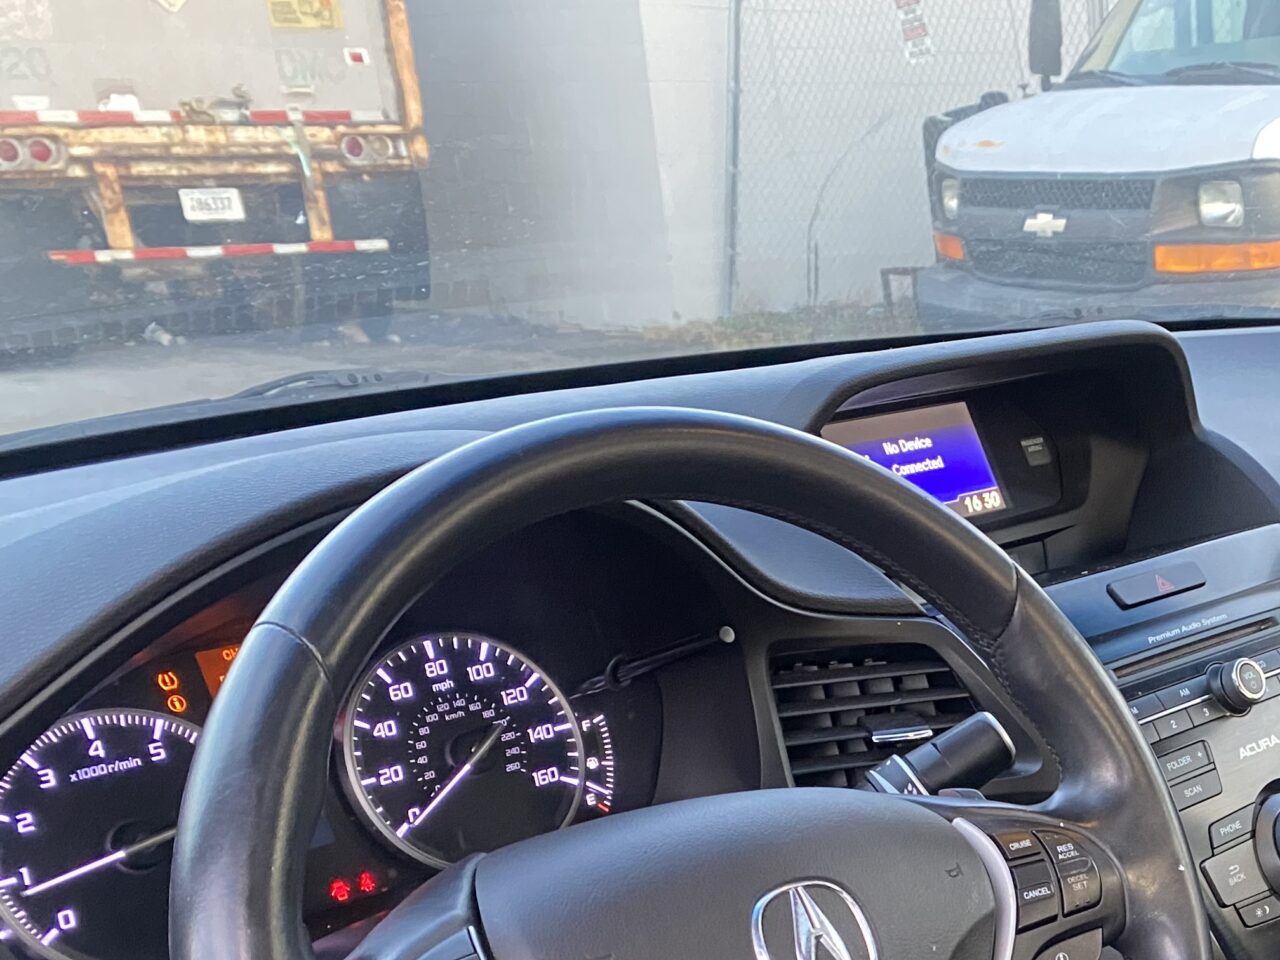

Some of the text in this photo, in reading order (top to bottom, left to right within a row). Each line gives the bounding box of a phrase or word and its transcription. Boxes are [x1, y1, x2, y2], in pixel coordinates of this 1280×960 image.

[882, 436, 933, 455] No Device
[891, 455, 945, 476] Connected
[1147, 613, 1228, 644] Premium Audio System
[425, 659, 448, 678] 80
[466, 662, 495, 682] 100
[389, 682, 413, 701] 60
[432, 679, 454, 693] mph
[1179, 688, 1191, 697] AM
[500, 686, 528, 706] 120
[436, 703, 450, 712] 120
[452, 699, 466, 708] 140
[468, 702, 482, 711] 160
[425, 713, 439, 723] 100
[444, 710, 465, 721] km/h
[1203, 707, 1210, 717] 3
[373, 720, 397, 738] 40
[418, 726, 430, 736] 80
[581, 719, 591, 732] F
[1170, 720, 1177, 729] 2
[501, 732, 516, 742] 220
[527, 723, 555, 743] 140
[88, 740, 105, 758] 4
[148, 741, 167, 762] 5
[415, 741, 427, 750] 60
[505, 746, 520, 757] 240
[1239, 734, 1280, 760] ACURA
[417, 755, 428, 764] 40
[1166, 755, 1193, 772] FOLDER
[505, 761, 520, 772] 260
[37, 768, 57, 789] 3
[378, 765, 404, 785] 20
[423, 770, 435, 780] 20
[531, 766, 560, 787] 160
[1183, 784, 1203, 798] SCAN
[585, 793, 597, 806] E
[15, 812, 36, 833] 2
[1219, 820, 1243, 837] PHONE
[1009, 839, 1033, 851] CRUISE
[1056, 843, 1074, 853] RES
[1058, 850, 1080, 860] ACCEL
[18, 867, 31, 886] 1
[1067, 874, 1089, 884] DECEL
[1228, 872, 1247, 886] BACK
[1072, 881, 1088, 891] SET
[1023, 887, 1051, 900] CANCEL
[57, 909, 76, 930] 0
